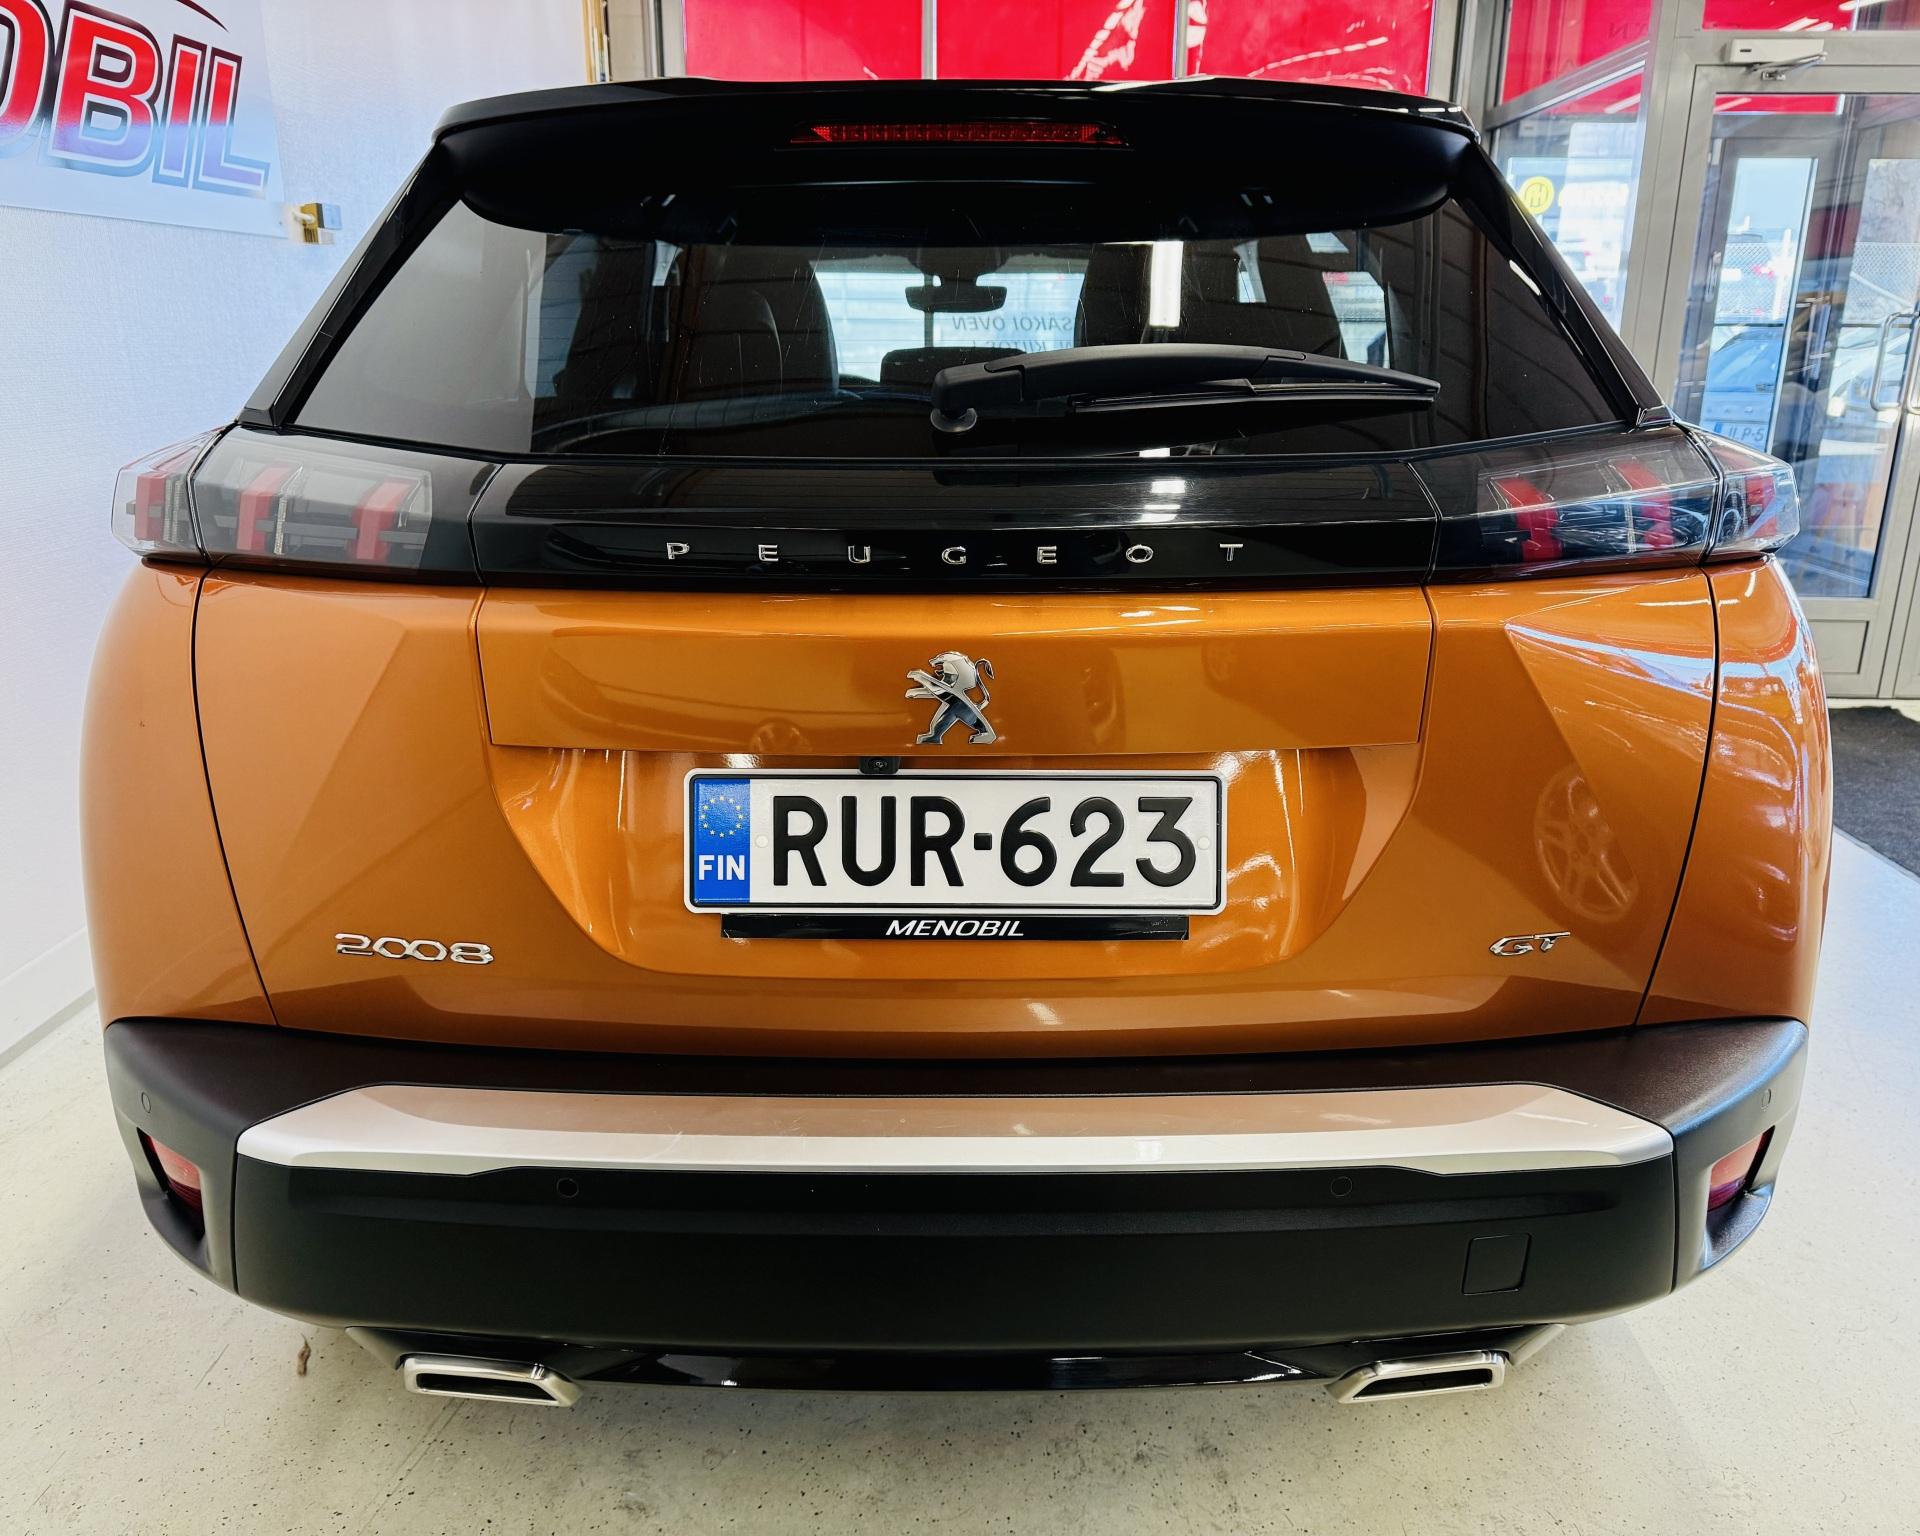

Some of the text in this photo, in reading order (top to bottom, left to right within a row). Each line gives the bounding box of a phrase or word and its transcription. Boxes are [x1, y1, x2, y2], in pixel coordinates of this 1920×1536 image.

[666, 541, 1244, 565] PEUGEOT
[699, 795, 1197, 888] FIN RUR-623
[885, 919, 1024, 937] MENOBIL
[334, 932, 494, 965] 2008
[1489, 931, 1572, 956] GT
